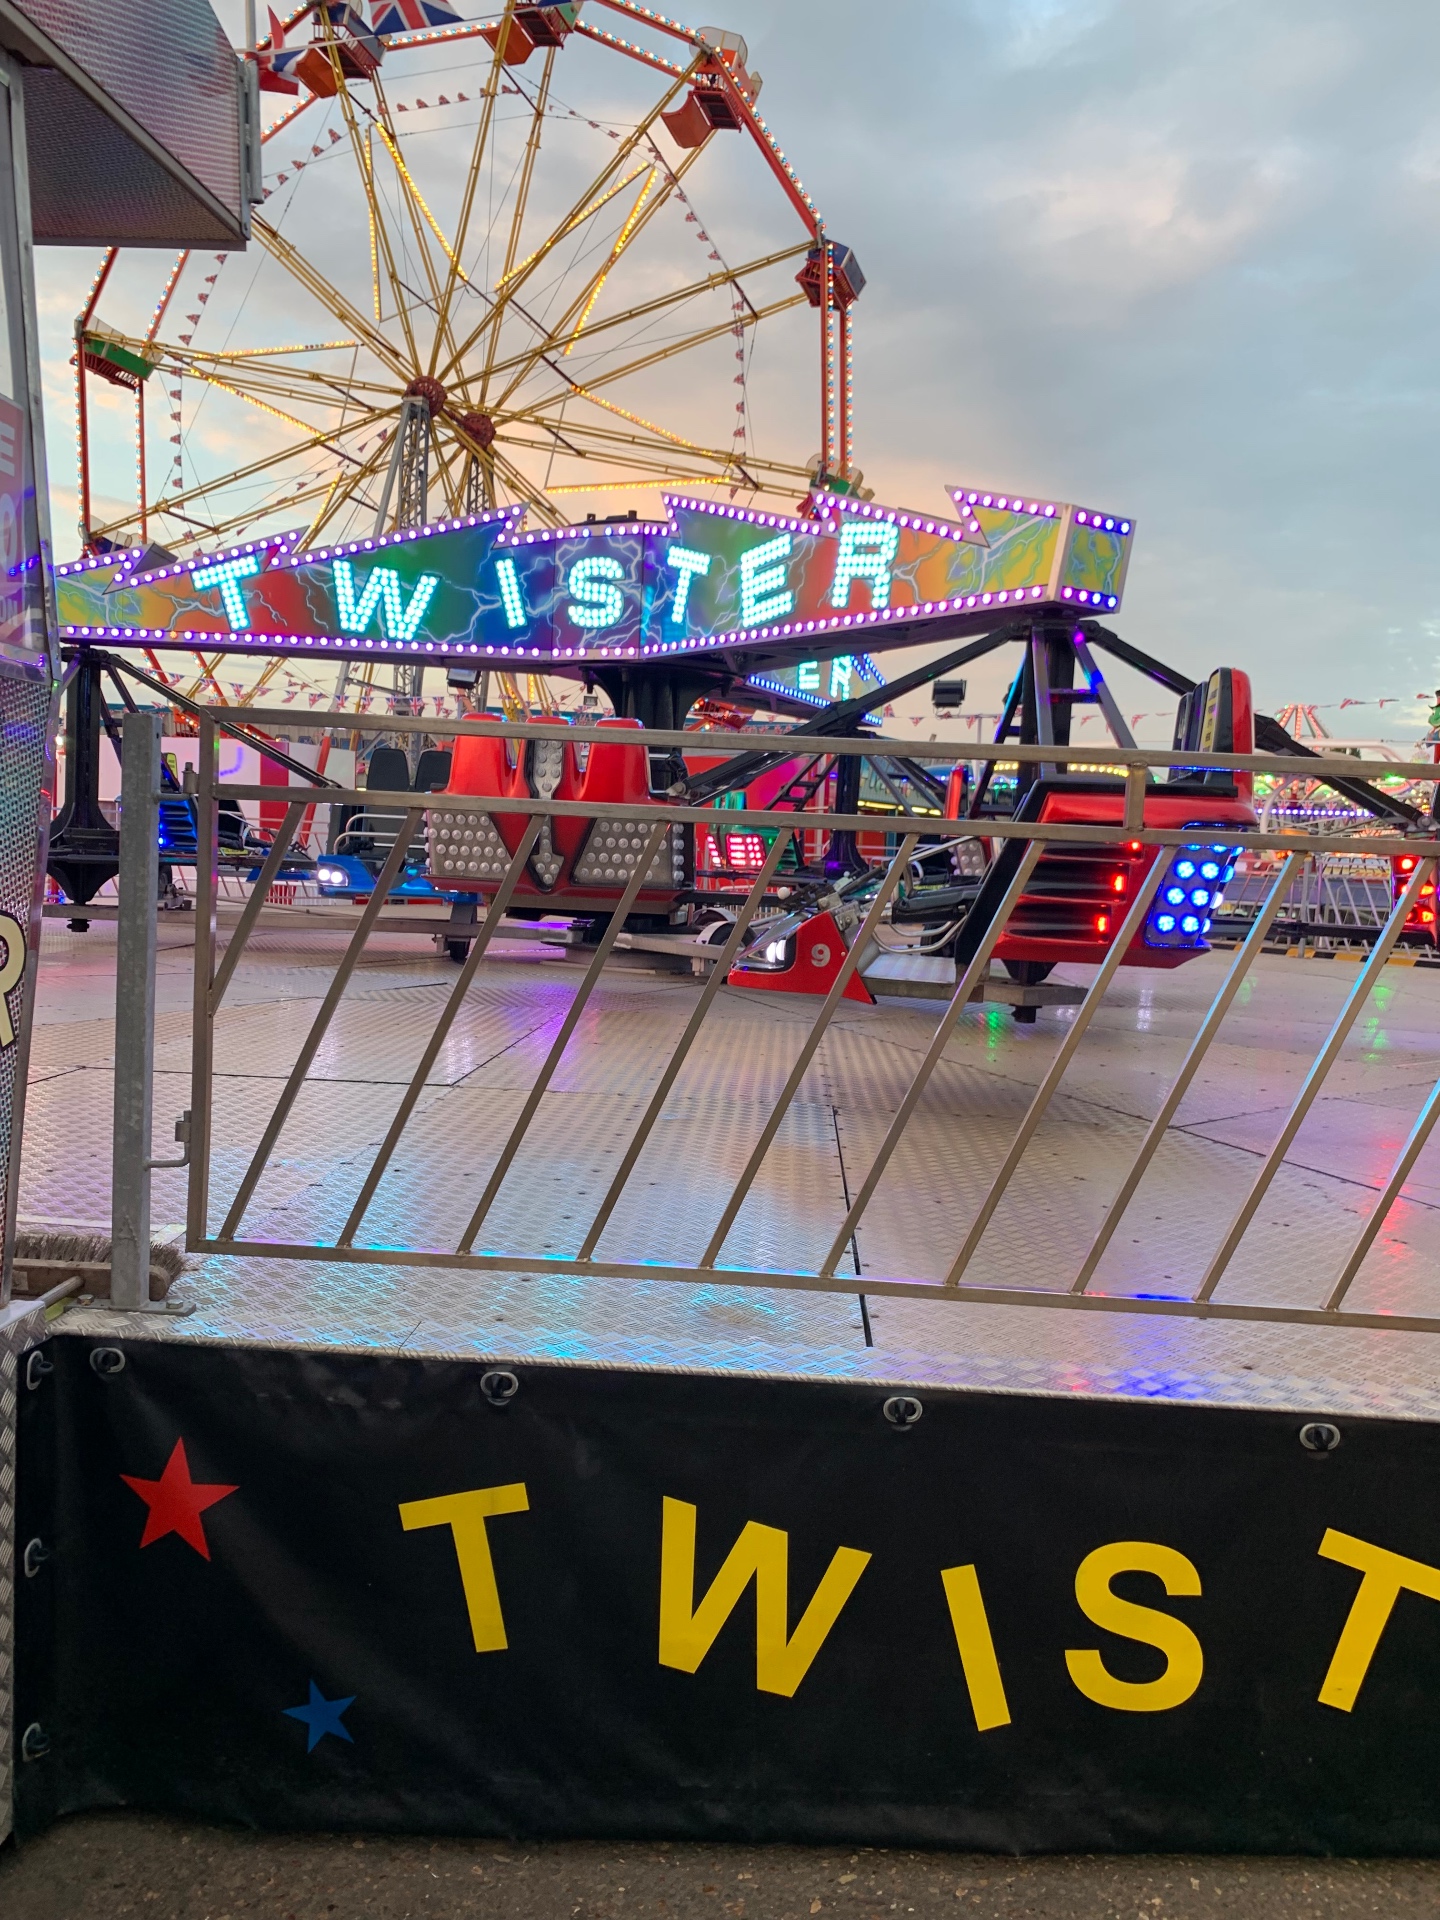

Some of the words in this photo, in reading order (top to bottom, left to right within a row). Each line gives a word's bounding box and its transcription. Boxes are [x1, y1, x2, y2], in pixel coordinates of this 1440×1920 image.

[191, 521, 900, 642] TWISTER
[811, 943, 831, 967] 9
[398, 1482, 1440, 1732] TWIST
